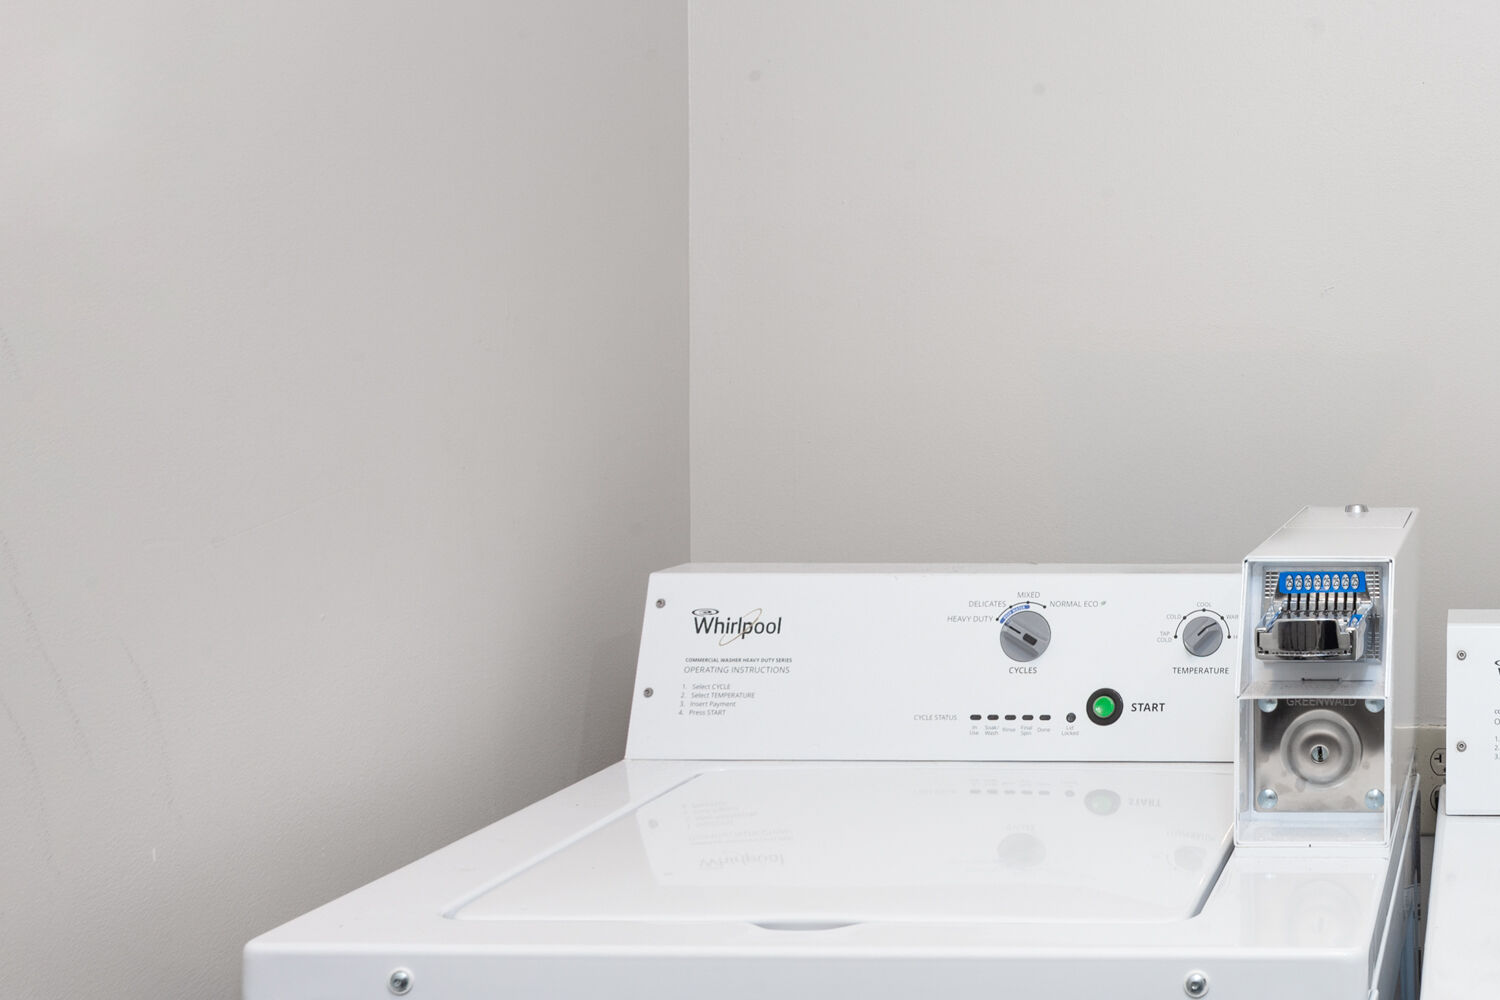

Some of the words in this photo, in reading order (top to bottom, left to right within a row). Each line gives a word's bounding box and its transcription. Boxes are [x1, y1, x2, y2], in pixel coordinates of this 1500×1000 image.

[694, 616, 782, 639] Whirlpool
[683, 666, 729, 674] OPERATING
[731, 666, 790, 674] INSTRUCTIONS
[1286, 698, 1357, 706] GREENWALD
[1131, 703, 1166, 712] START
